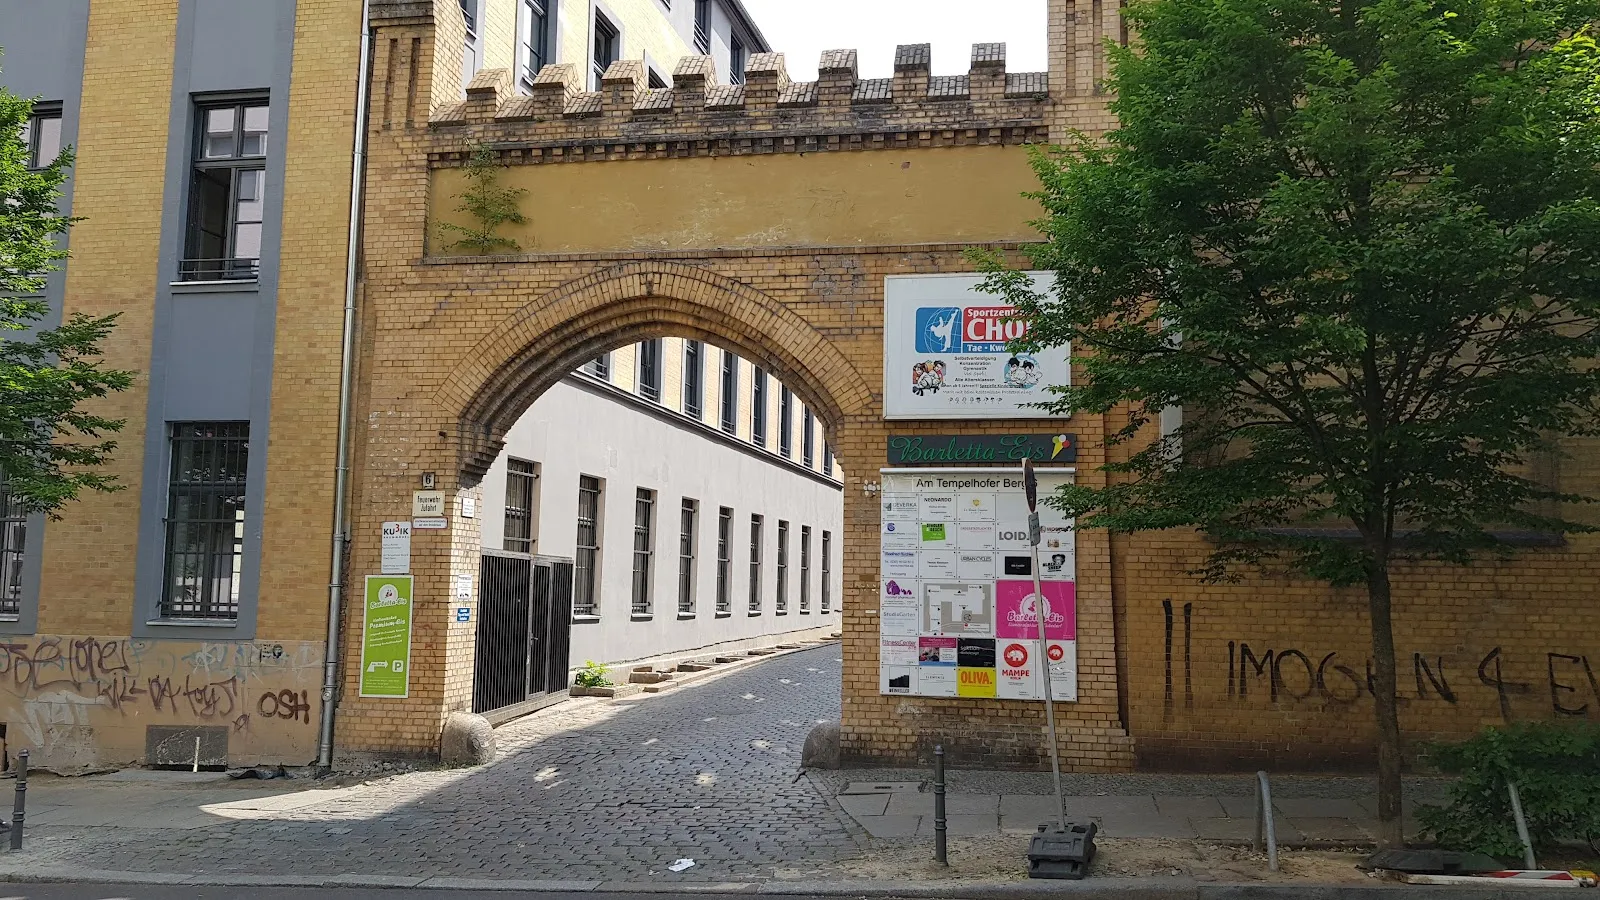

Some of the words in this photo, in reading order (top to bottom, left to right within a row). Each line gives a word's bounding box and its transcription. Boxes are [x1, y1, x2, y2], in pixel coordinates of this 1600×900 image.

[967, 344, 982, 352] Tae
[890, 435, 1045, 462] Barletta-Eis
[425, 475, 431, 485] 6
[916, 479, 933, 488] Am
[938, 478, 999, 490] Tempelhofer
[420, 504, 437, 512] Zufahrt
[999, 531, 1030, 541] LOID
[1002, 669, 1030, 677] MAMPE
[257, 688, 311, 725] OSH
